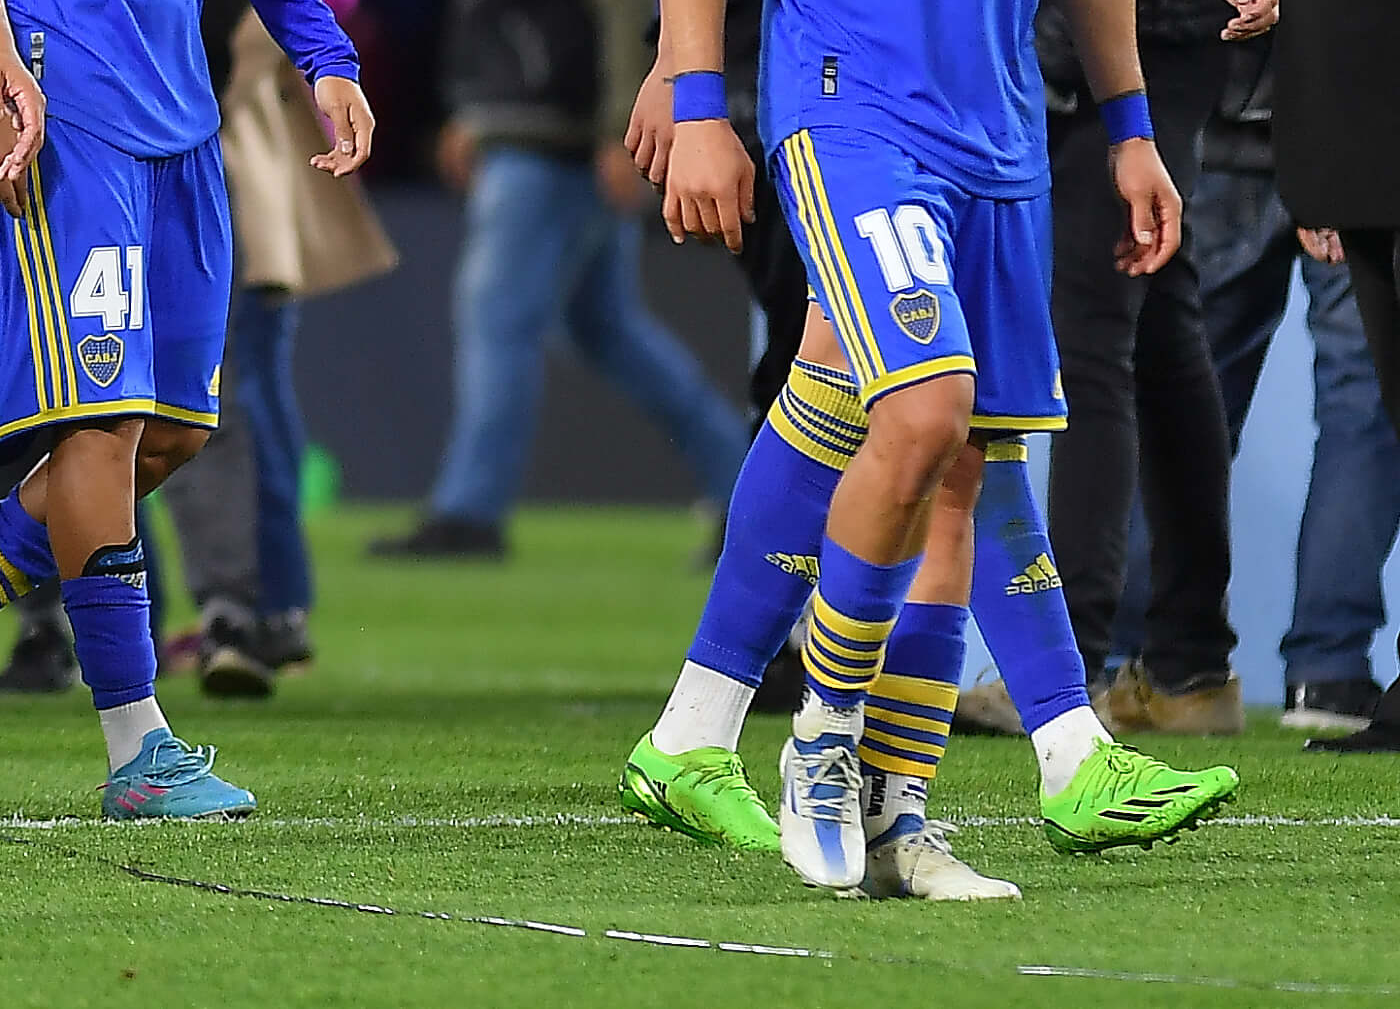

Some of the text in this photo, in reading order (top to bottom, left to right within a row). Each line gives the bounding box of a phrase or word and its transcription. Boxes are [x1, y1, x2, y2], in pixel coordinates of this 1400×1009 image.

[69, 246, 144, 331] 41
[853, 205, 952, 293] 10
[901, 307, 935, 323] CABJ
